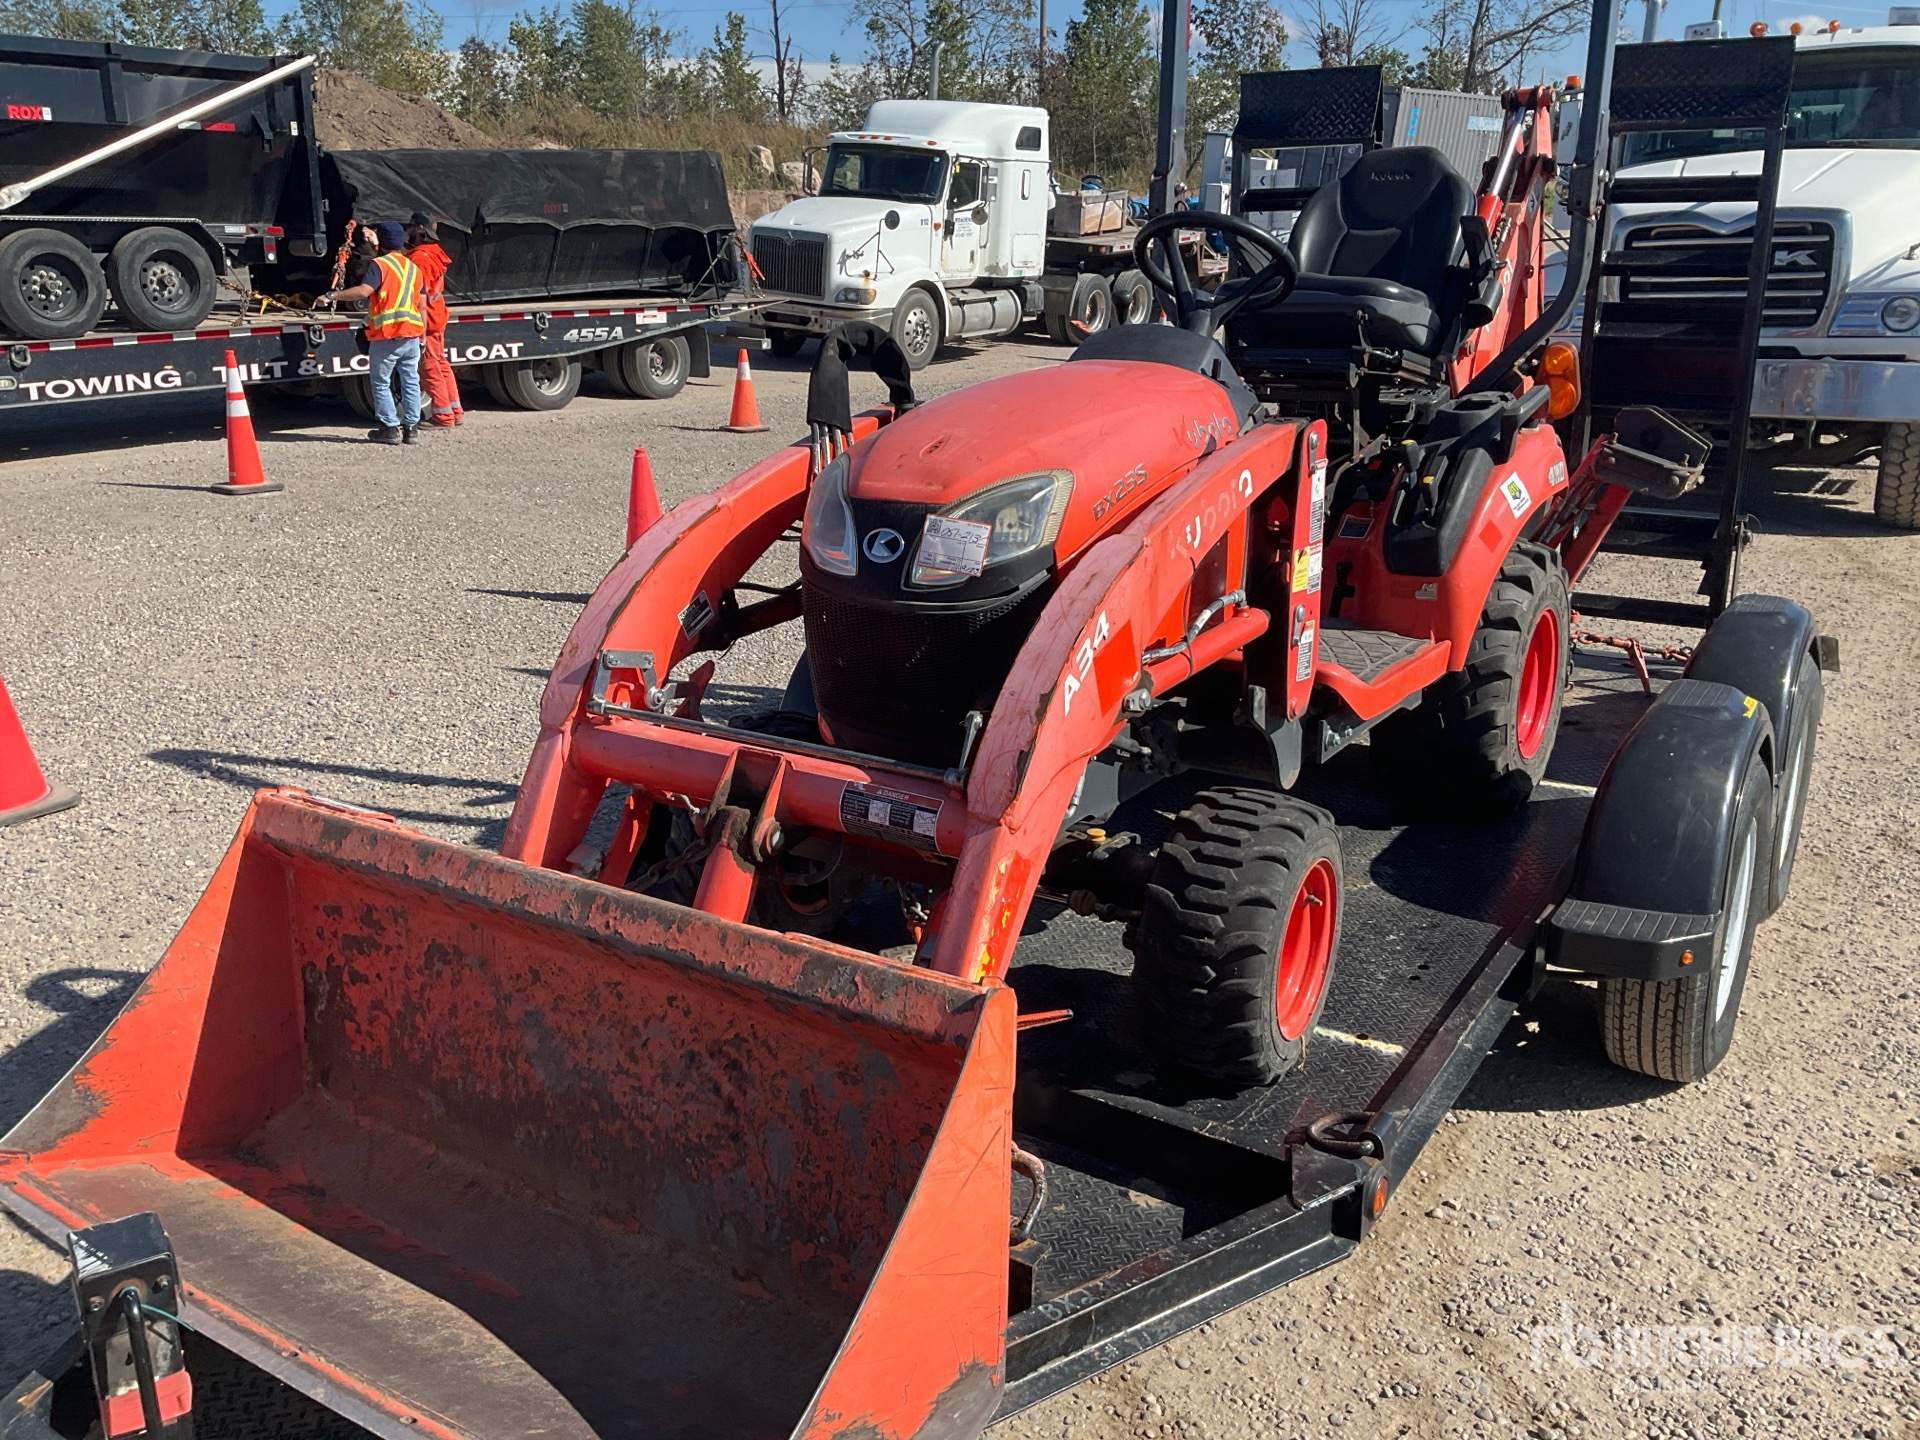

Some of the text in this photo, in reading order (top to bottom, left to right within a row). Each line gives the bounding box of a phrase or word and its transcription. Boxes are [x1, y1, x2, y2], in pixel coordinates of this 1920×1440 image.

[7, 103, 43, 120] ROX
[563, 326, 625, 343] 455A
[18, 369, 183, 401] TOWING
[212, 360, 288, 383] TILT
[297, 358, 324, 376] &
[1092, 462, 1148, 521] BX23S
[1064, 610, 1110, 718] A34
[882, 789, 910, 800] DANGER
